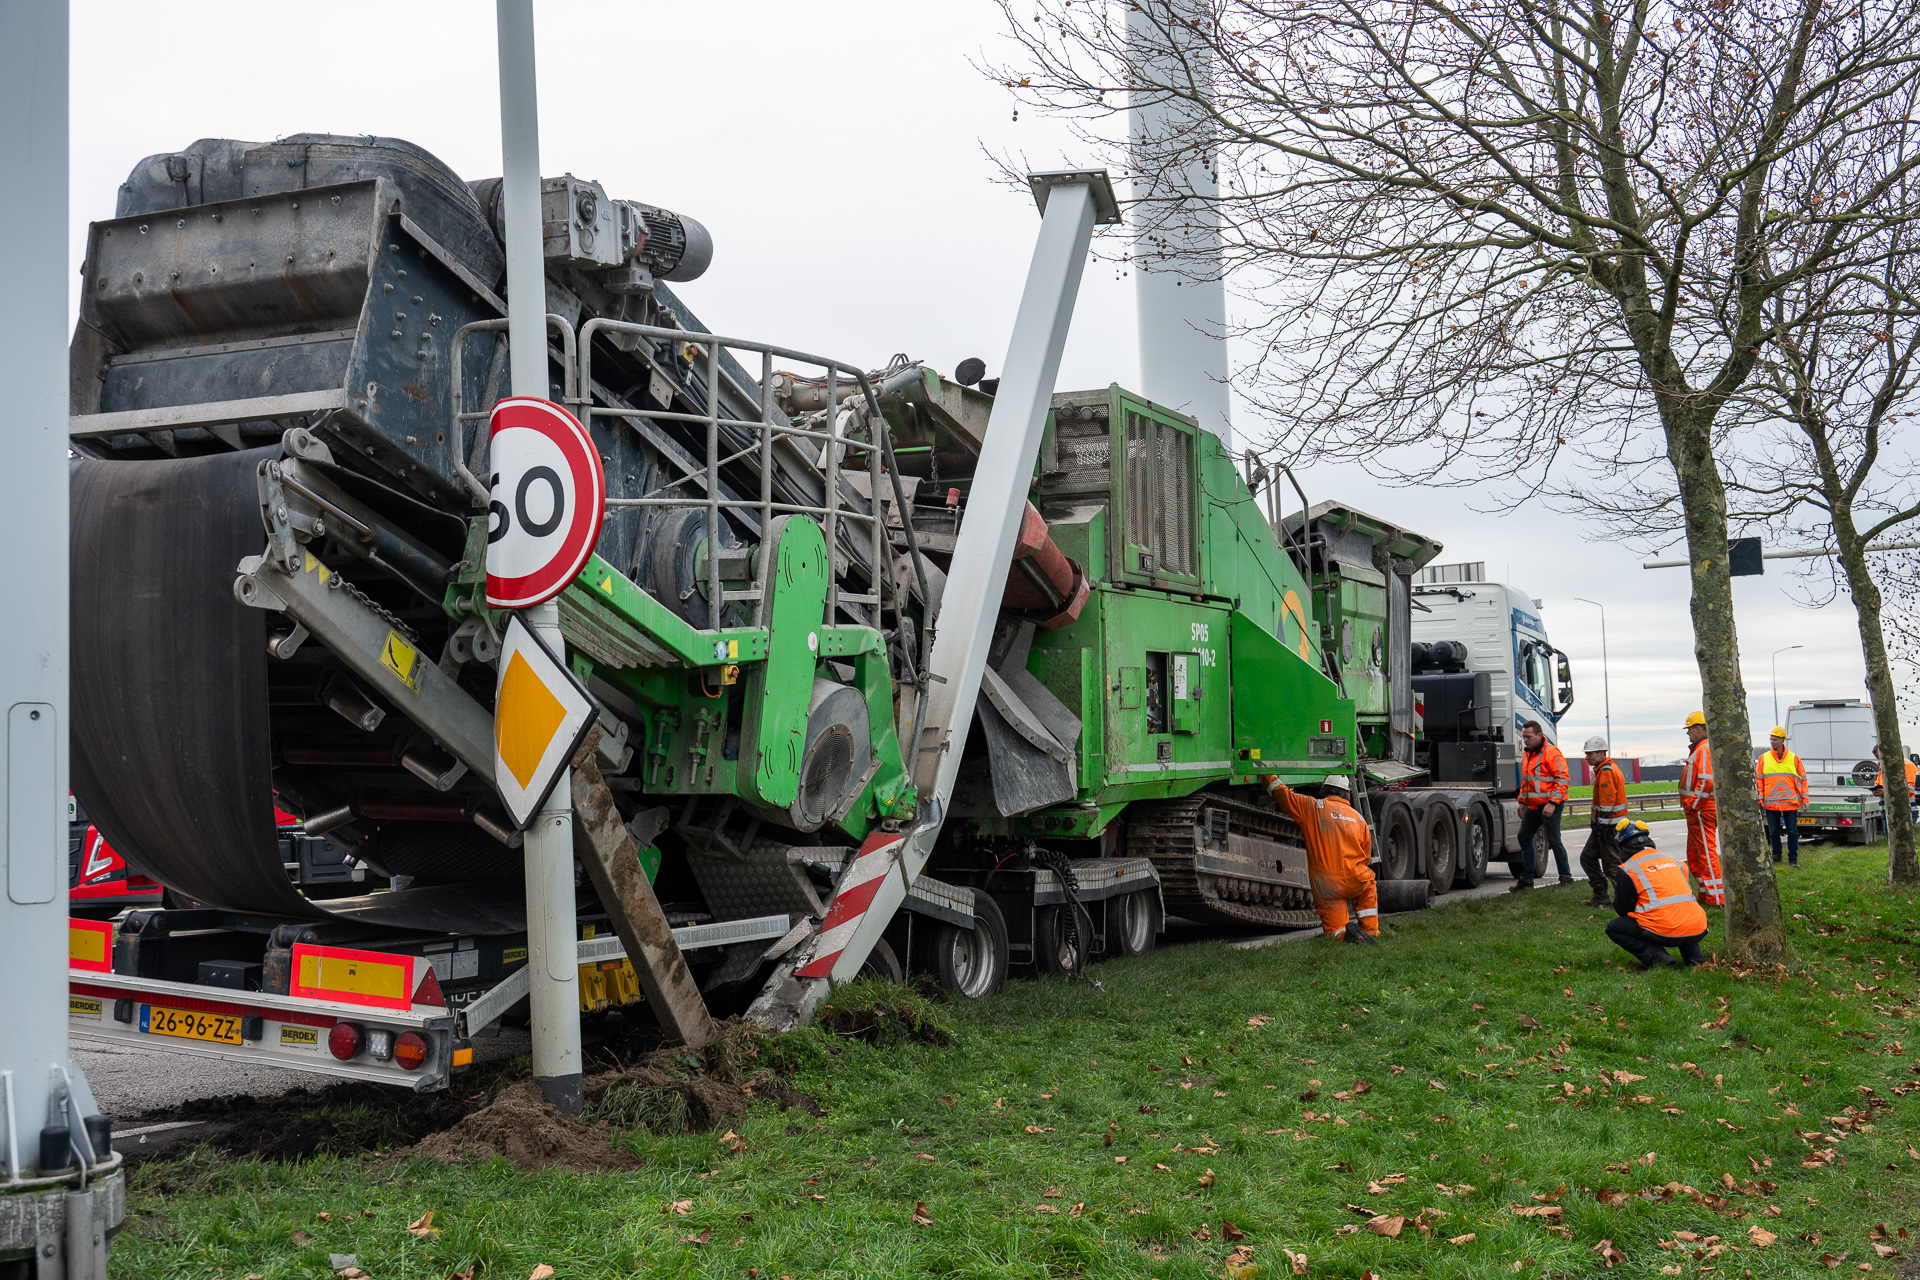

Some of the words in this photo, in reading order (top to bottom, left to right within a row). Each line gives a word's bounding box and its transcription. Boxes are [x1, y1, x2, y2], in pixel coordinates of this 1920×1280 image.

[1191, 622, 1209, 642] SP05
[504, 950, 526, 959] BERDEX
[70, 1000, 100, 1012] BERDEX
[155, 1010, 235, 1040] 26-96-ZZ
[282, 1029, 316, 1042] BERDEX
